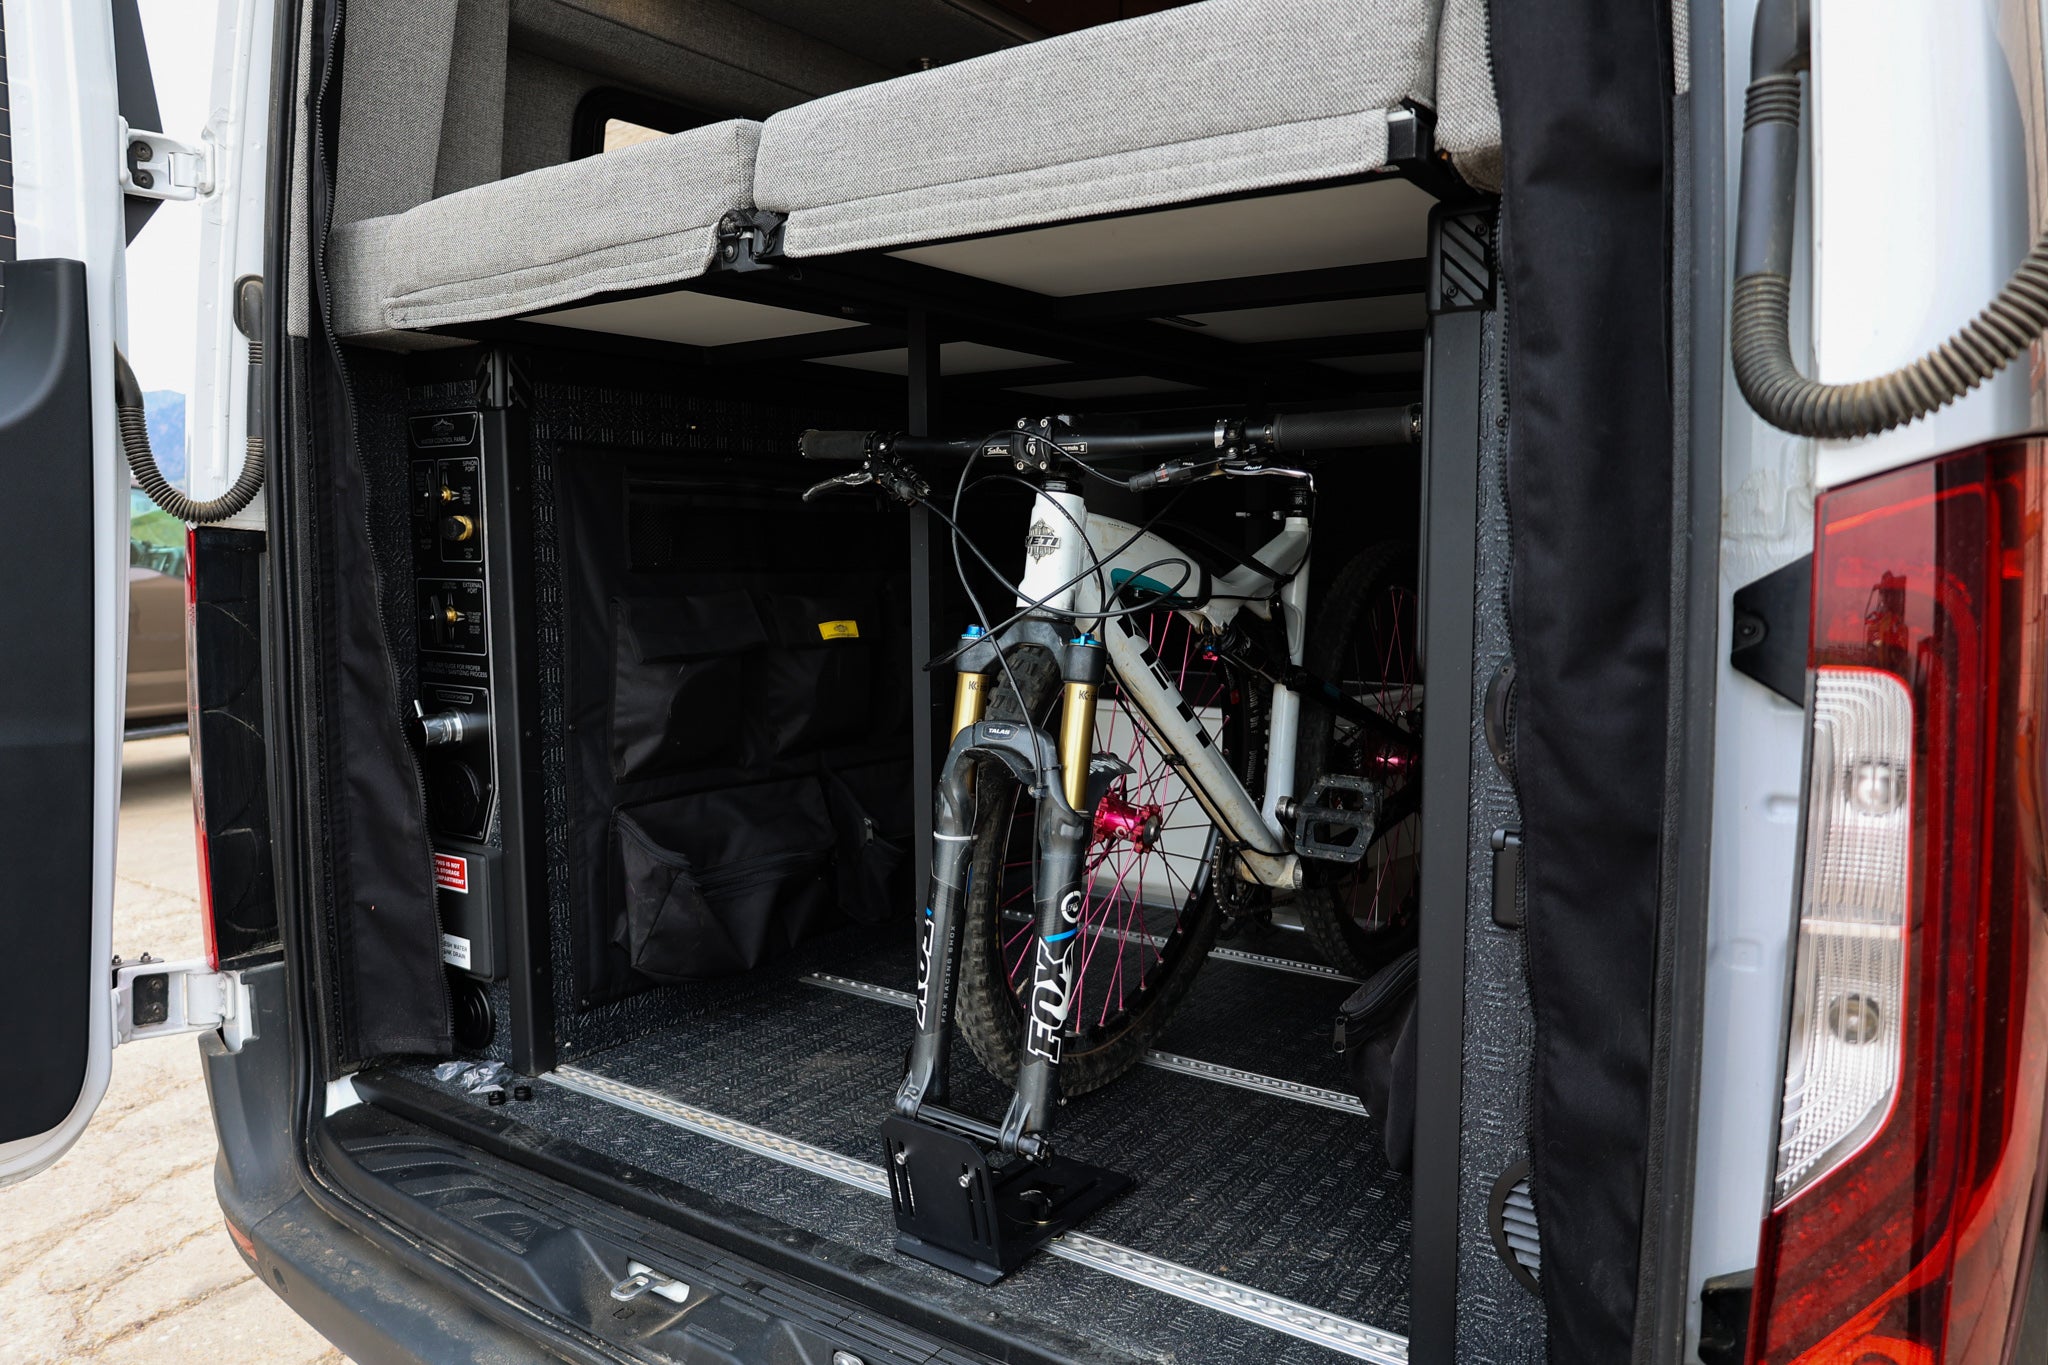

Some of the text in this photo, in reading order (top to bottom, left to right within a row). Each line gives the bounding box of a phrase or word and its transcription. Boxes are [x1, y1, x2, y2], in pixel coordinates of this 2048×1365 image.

[988, 727, 1011, 735] TALAS
[451, 862, 460, 870] NOT
[440, 868, 460, 877] STORAGE
[453, 943, 467, 952] WATER
[453, 951, 466, 960] DRAIN
[943, 957, 953, 999] RACING
[948, 925, 956, 953] SHOX
[1028, 937, 1075, 1064] FOX
